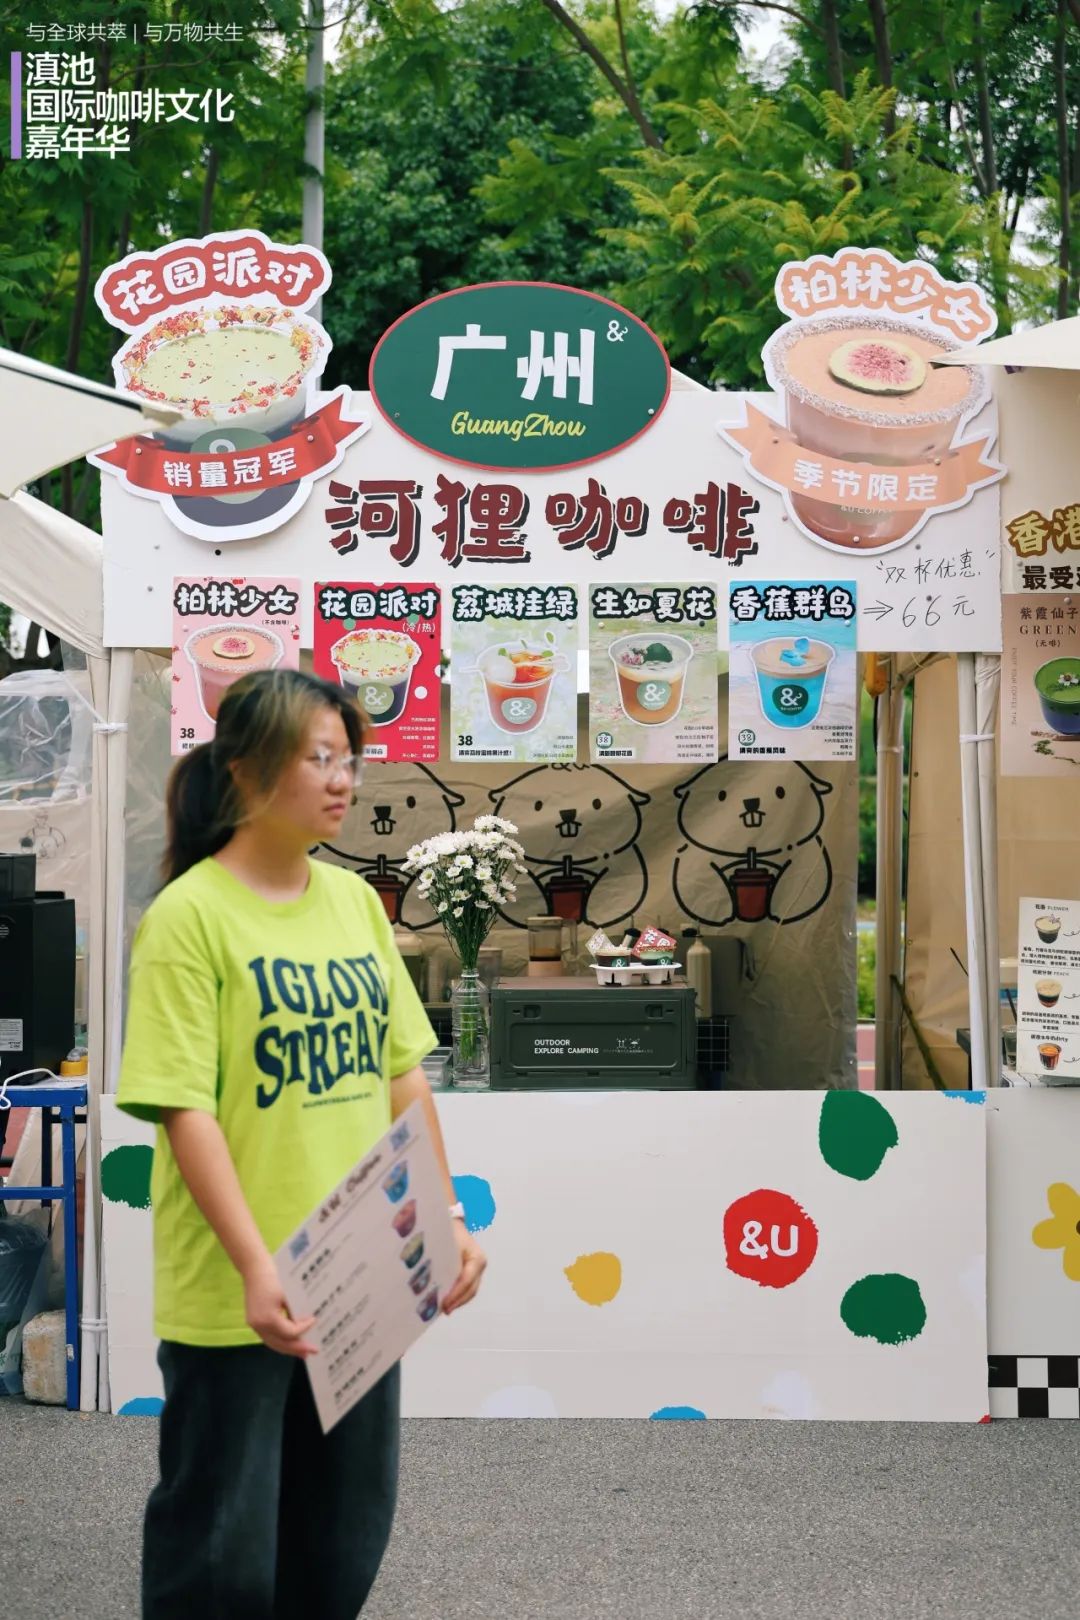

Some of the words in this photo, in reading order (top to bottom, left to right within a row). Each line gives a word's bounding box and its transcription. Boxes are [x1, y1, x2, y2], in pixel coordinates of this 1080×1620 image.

[112, 247, 314, 316] 花园派对
[788, 261, 983, 334] 柏林少女
[430, 323, 596, 406] 广州
[451, 410, 586, 442] GuangZhou
[162, 446, 298, 489] 销量冠军
[793, 458, 939, 502] 季节限定
[324, 472, 761, 568] 河狸咖啡
[1021, 564, 1080, 591] 最受
[175, 582, 297, 617] 柏林少女
[320, 586, 440, 621] 花园派对
[452, 585, 579, 622] 荔城挂绿
[592, 586, 717, 622] 生如夏花
[730, 584, 855, 621] 香蕉群岛
[1019, 606, 1079, 620] 紫霞仙子
[1019, 624, 1077, 635] GREEN
[179, 727, 195, 739] 38
[457, 735, 474, 747] 38
[534, 1039, 571, 1047] OUTDOOR
[567, 1047, 600, 1055] CAMPING
[738, 1219, 800, 1260] &U
